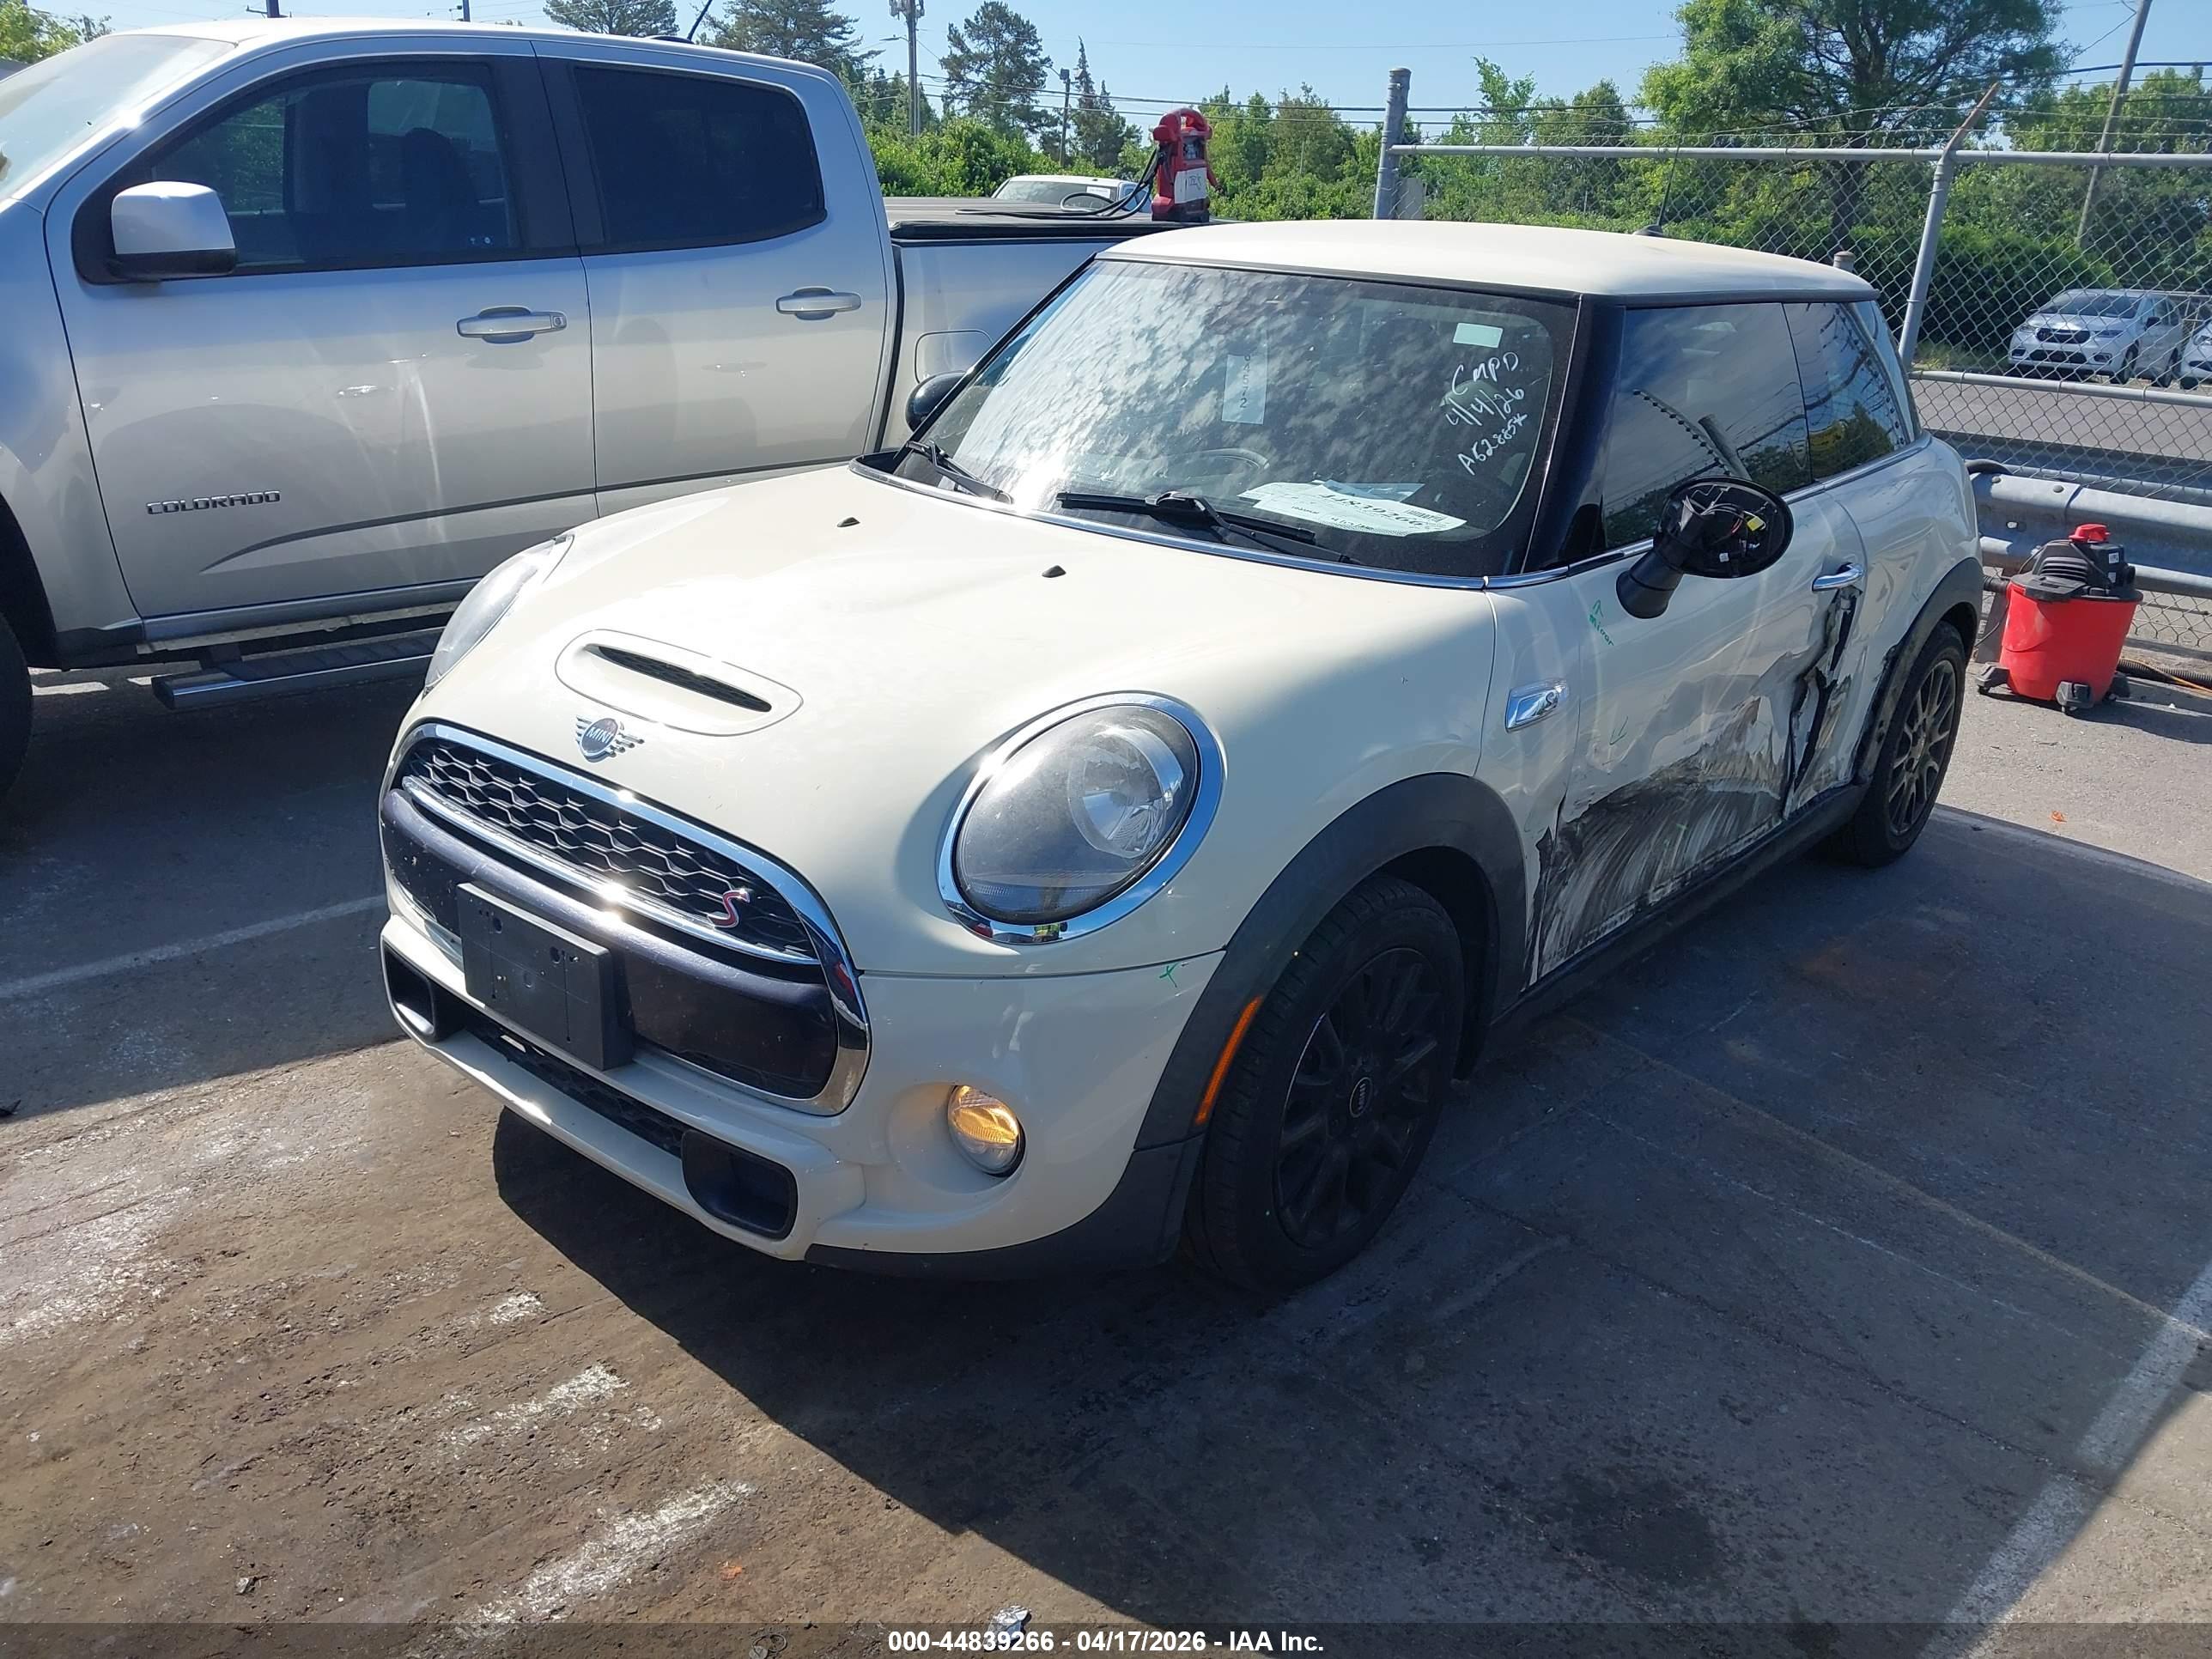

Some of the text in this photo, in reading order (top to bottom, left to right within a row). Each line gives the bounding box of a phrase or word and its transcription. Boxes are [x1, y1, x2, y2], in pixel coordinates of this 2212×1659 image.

[147, 490, 281, 514] COLORADO
[586, 726, 613, 744] MINI
[707, 888, 750, 929] S
